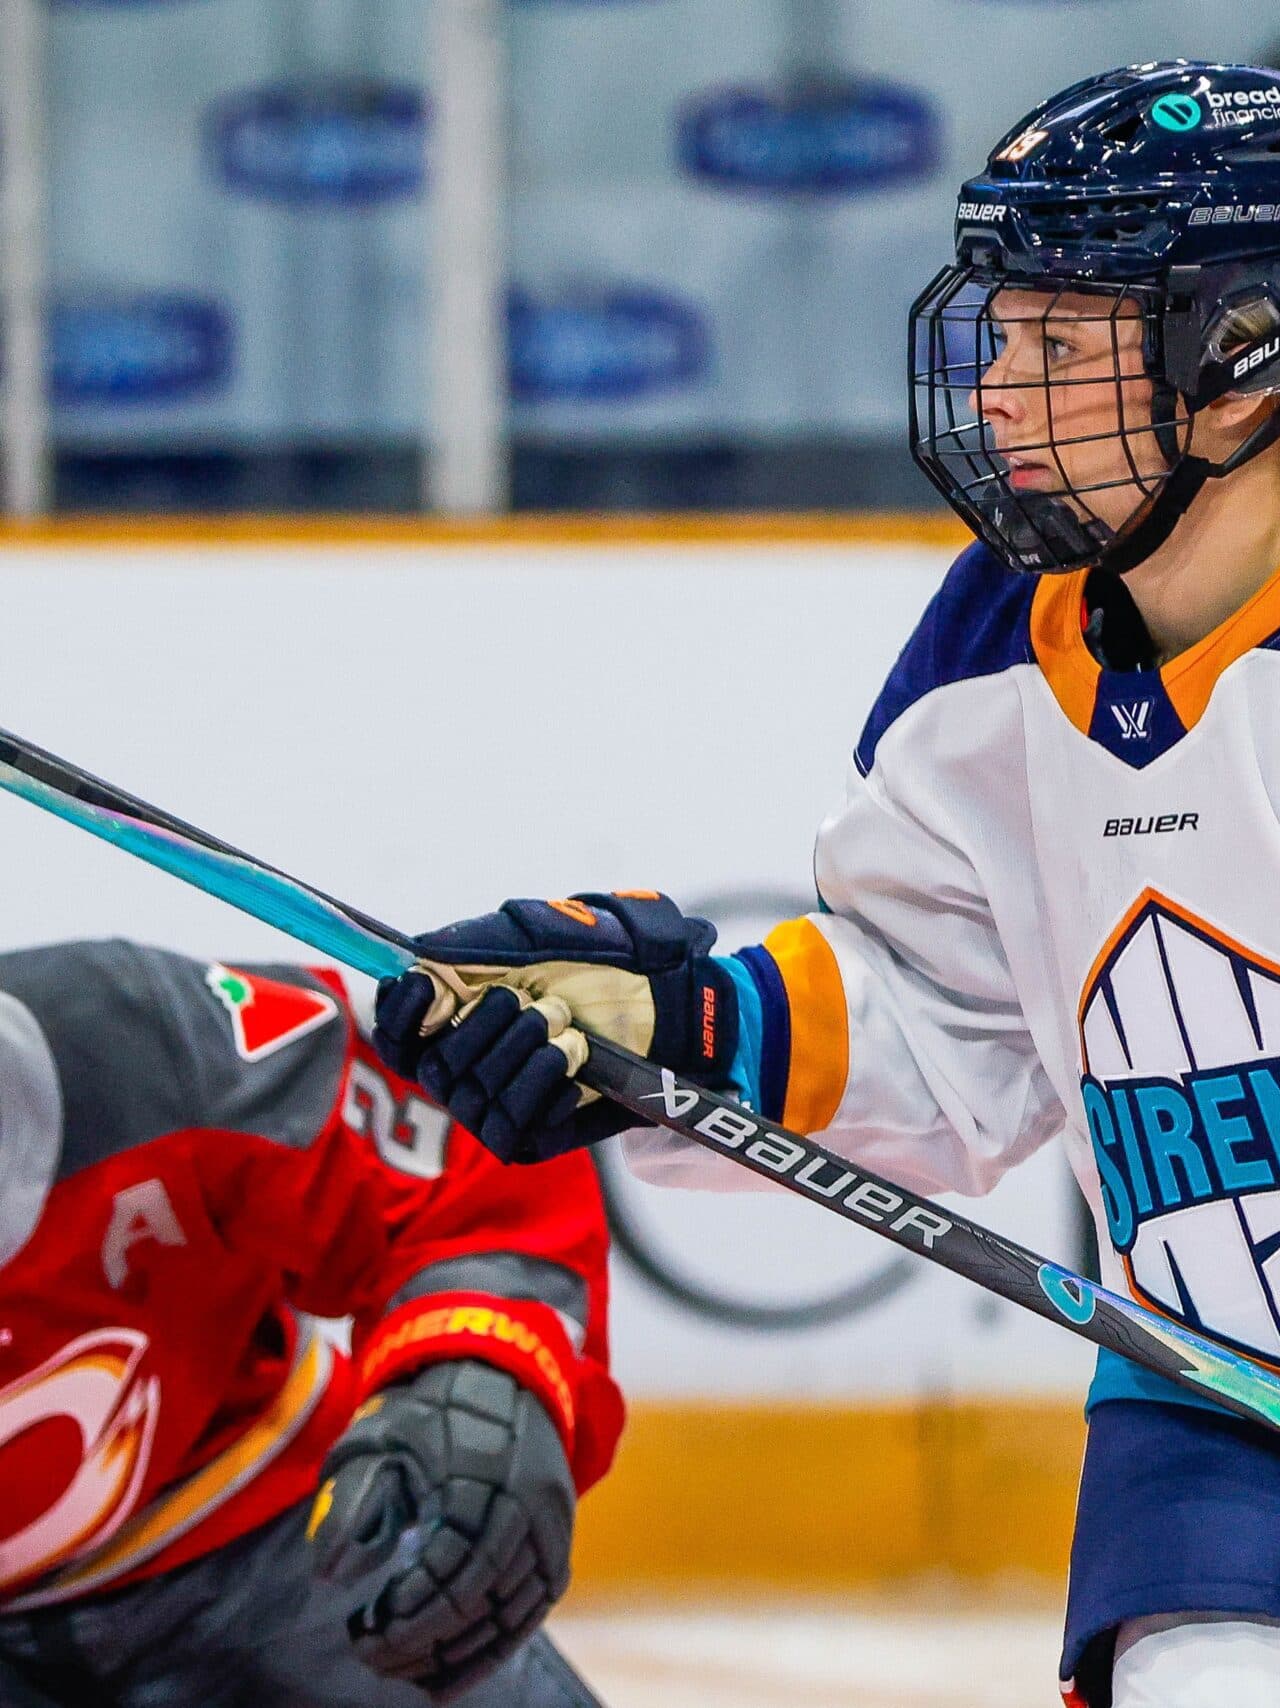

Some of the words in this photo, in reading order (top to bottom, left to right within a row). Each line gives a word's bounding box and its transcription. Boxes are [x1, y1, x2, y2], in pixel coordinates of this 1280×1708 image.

[1102, 812, 1199, 837] BAUER
[101, 1177, 188, 1290] A
[694, 1106, 953, 1249] BAUER
